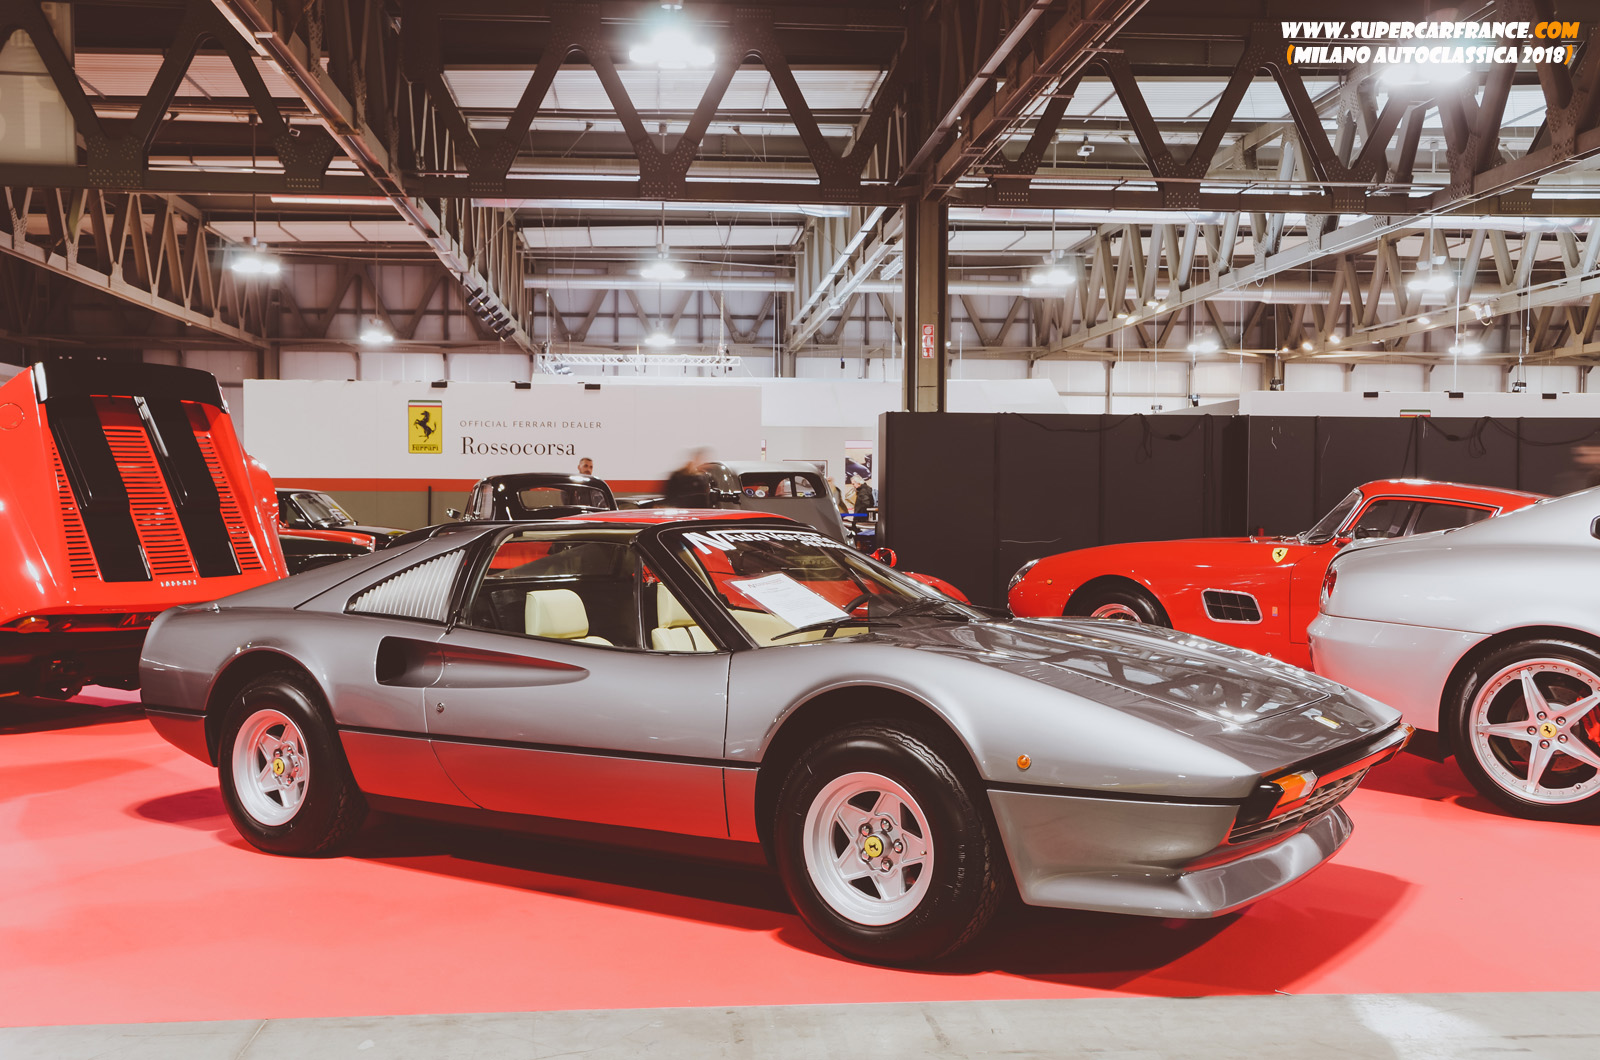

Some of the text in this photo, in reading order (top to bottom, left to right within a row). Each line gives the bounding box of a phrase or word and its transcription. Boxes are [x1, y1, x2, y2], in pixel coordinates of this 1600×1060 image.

[459, 420, 602, 429] OFFICIAL FERRARI DEALER
[460, 436, 576, 456] Rossocorsa
